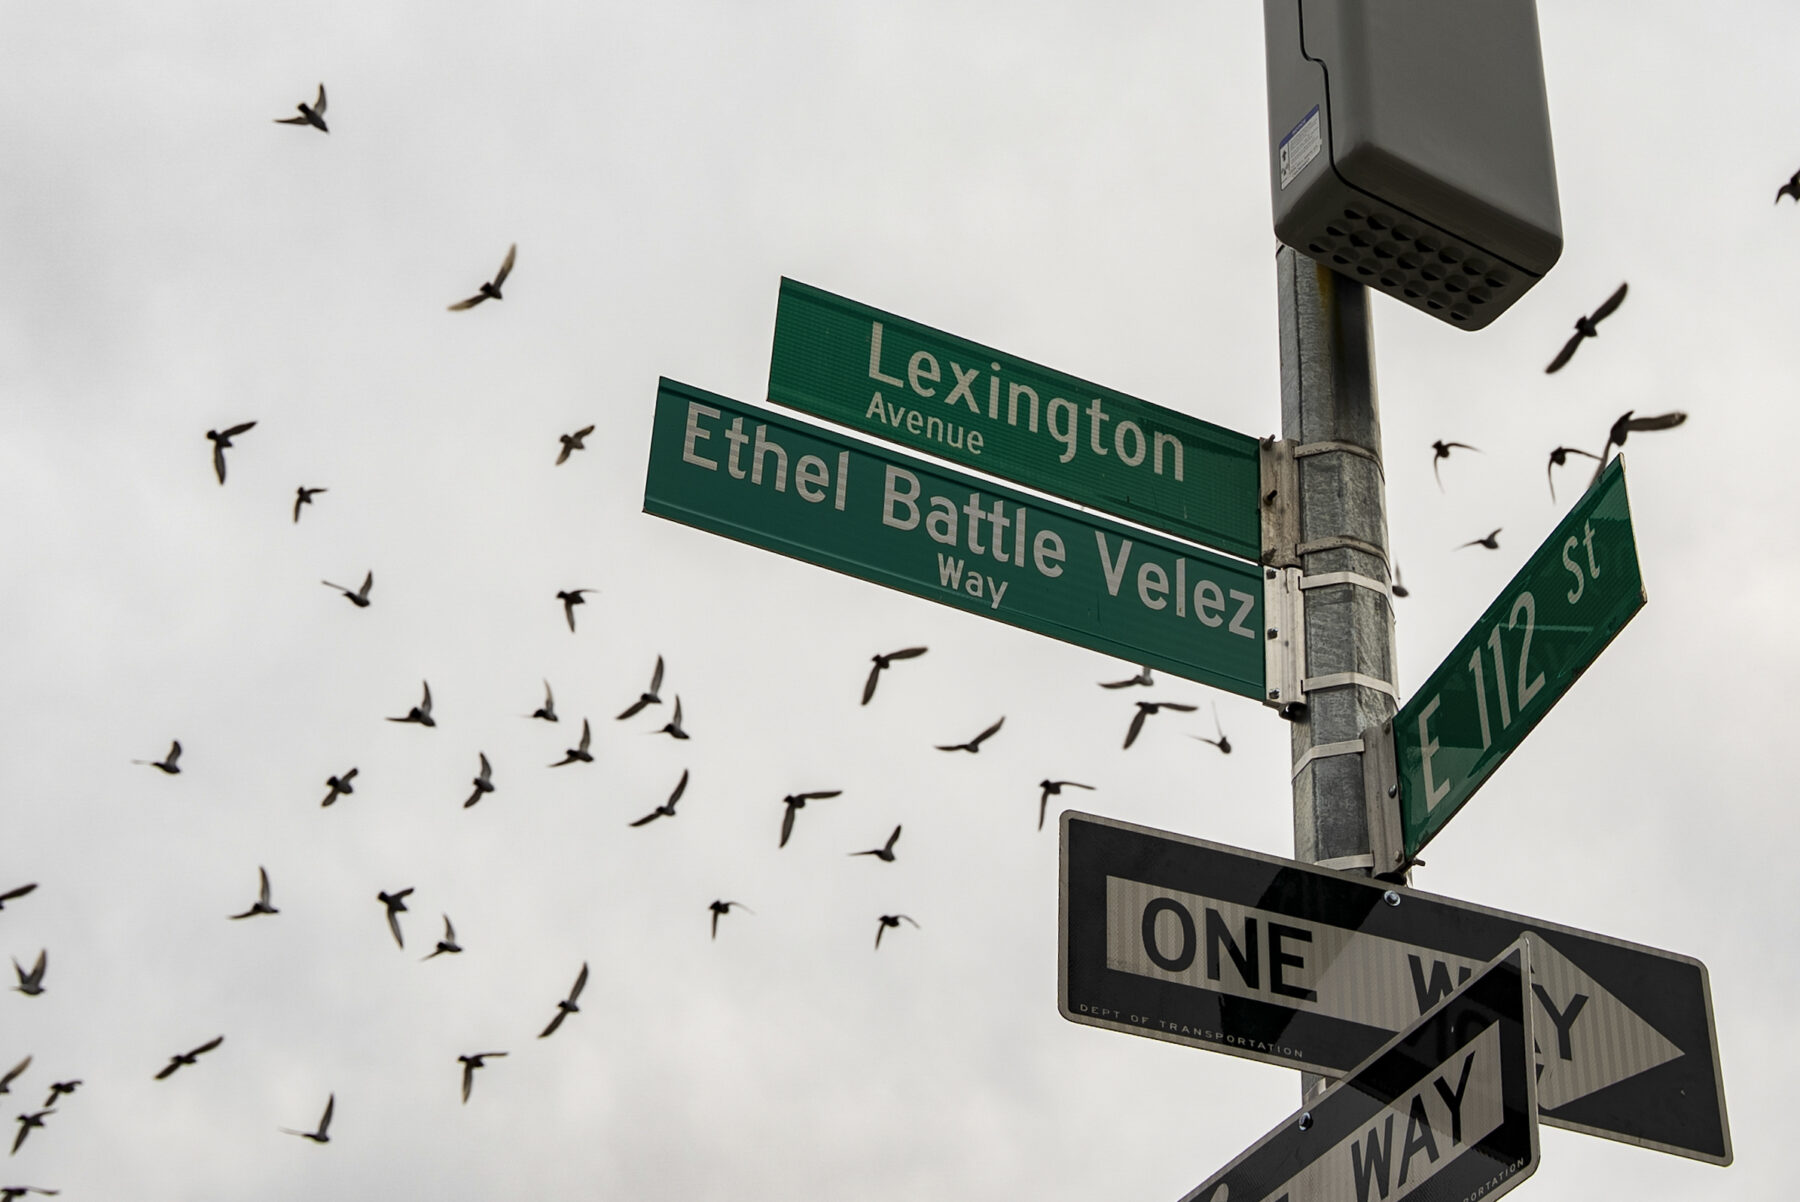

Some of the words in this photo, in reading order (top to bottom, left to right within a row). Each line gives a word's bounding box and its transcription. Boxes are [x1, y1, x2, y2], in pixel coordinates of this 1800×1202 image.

[865, 391, 985, 455] Avenue
[868, 321, 1185, 482] Lexington
[681, 401, 850, 512] Ethel
[882, 465, 1066, 578] Battle
[1094, 531, 1257, 639] Velez
[937, 553, 1009, 609] Way
[1418, 693, 1451, 814] E
[1468, 590, 1547, 751] 112
[1561, 518, 1601, 606] St
[1079, 1003, 1121, 1019] DEPT
[1130, 1014, 1151, 1025] OF
[1159, 1019, 1304, 1058] TRANSPORTATION
[1141, 897, 1318, 1004] ONE
[1408, 953, 1590, 1062] WY
[1351, 1050, 1476, 1202] WAY
